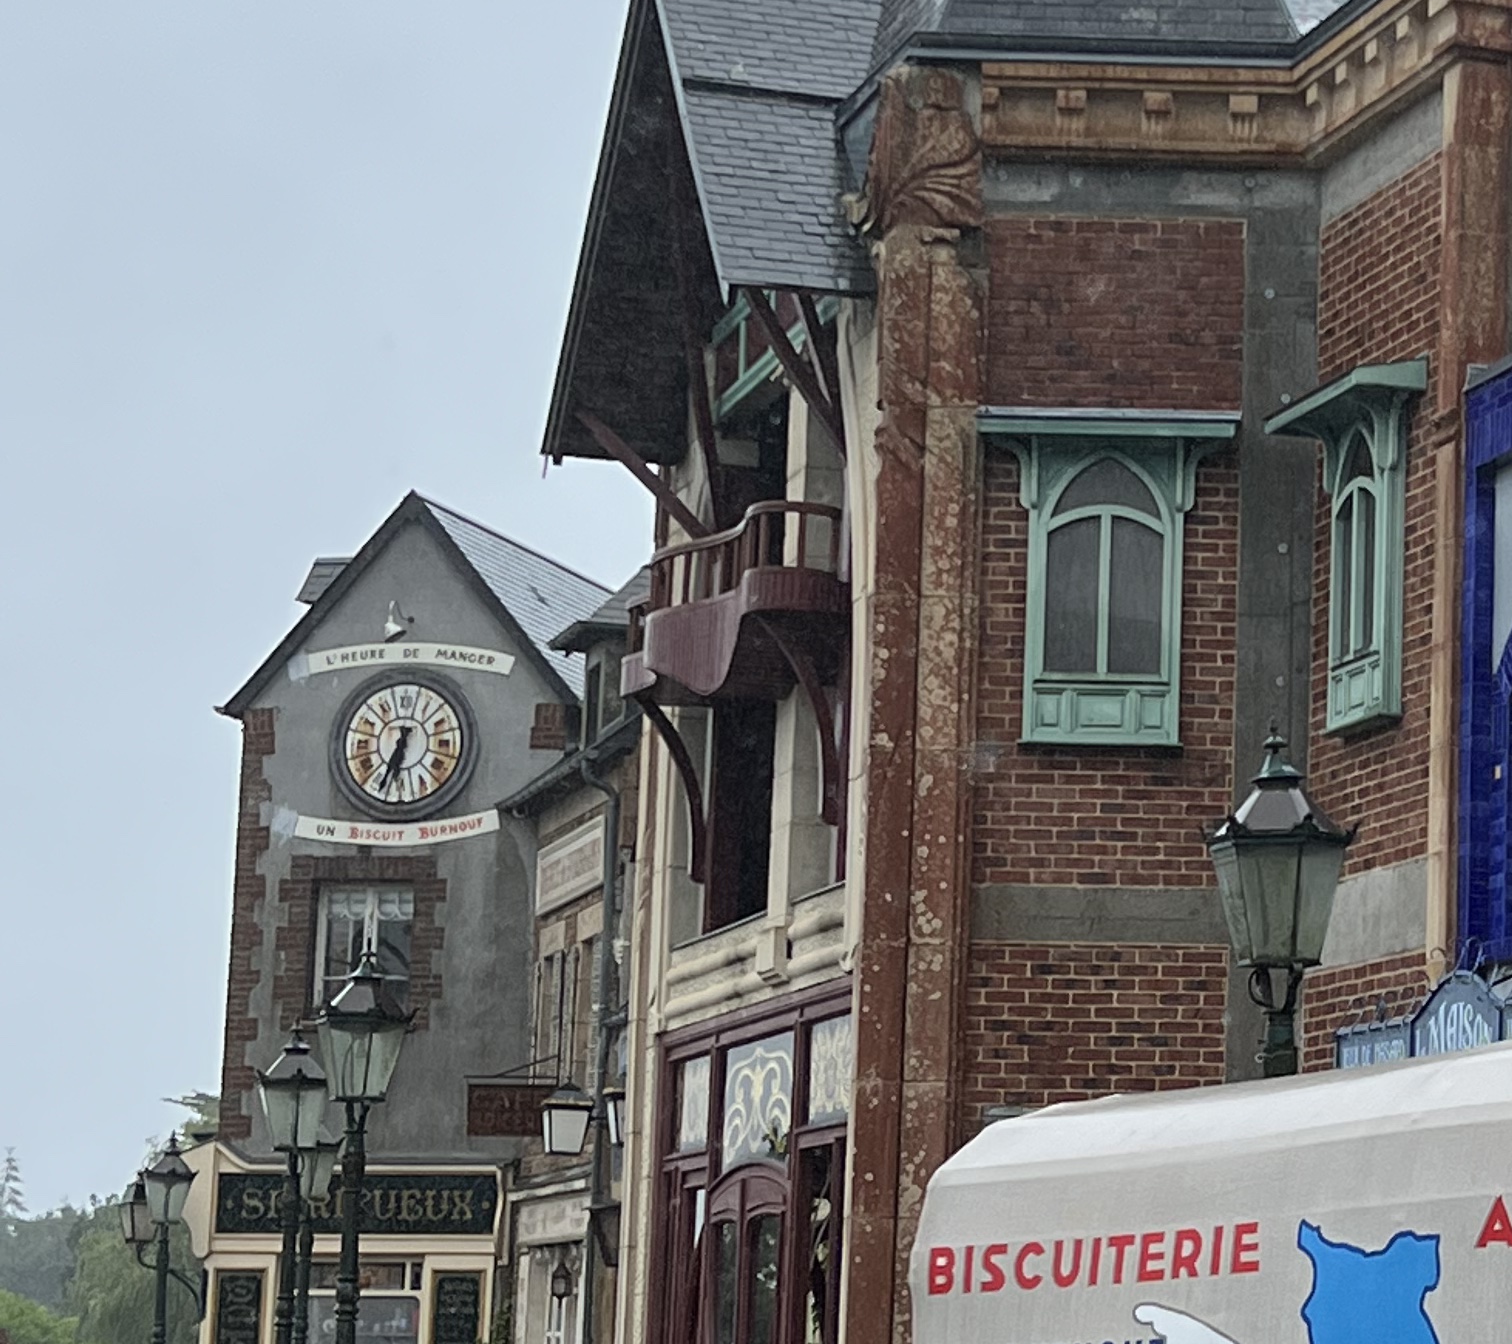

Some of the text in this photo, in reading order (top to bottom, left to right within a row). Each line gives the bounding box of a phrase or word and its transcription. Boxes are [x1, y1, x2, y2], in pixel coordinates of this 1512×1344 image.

[326, 648, 495, 666] L'HEURE DE MANGER
[316, 816, 483, 841] UN BISCUIT BURNOUF
[928, 1221, 1260, 1296] BISCUITERIE
